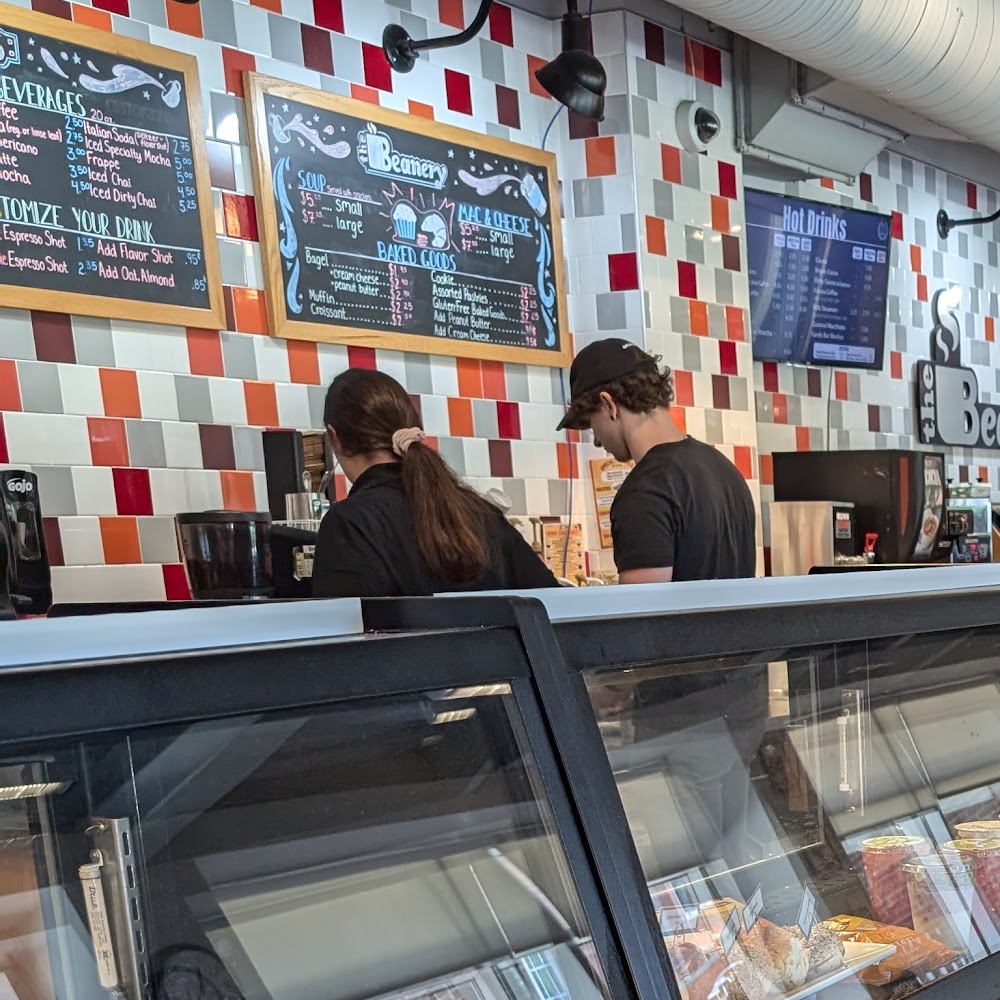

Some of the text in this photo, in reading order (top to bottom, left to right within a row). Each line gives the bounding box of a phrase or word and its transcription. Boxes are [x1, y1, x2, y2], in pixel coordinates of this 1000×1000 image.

[0, 101, 18, 120] ffee
[91, 108, 103, 120] 20
[66, 131, 84, 145] 2.75
[83, 120, 113, 139] Italian
[112, 127, 135, 145] Soda
[67, 147, 85, 161] 3.00
[85, 136, 192, 170] Iced Specialty Mocha 5.00
[366, 131, 447, 188] Beanery
[69, 165, 88, 178] 3.50
[86, 151, 193, 184] Frappe 5.00
[71, 180, 91, 195] 4.50
[88, 166, 196, 198] Iced Chai 4.50
[297, 169, 327, 192] SOUP
[90, 183, 197, 213] Iced Dirty Chai 5.25
[335, 198, 363, 217] small
[0, 195, 156, 244] TOMIZE YOUR DRINK
[336, 216, 364, 239] large
[458, 203, 531, 236] MAC & CHEESE
[783, 204, 848, 240] Hot Drinks
[3, 224, 43, 246] Espresso
[44, 229, 67, 249] Shot
[97, 239, 118, 257] Add
[120, 243, 149, 263] Flavor
[151, 248, 174, 265] Shot
[490, 229, 514, 246] small
[305, 248, 330, 270] Bagel
[376, 240, 457, 273] BAKED GOODS
[491, 245, 515, 264] large
[8, 250, 45, 272] Espresso
[44, 256, 69, 275] Shot
[78, 262, 97, 276] 2.35
[99, 261, 119, 280] Add
[141, 268, 175, 288] Almond
[356, 272, 380, 285] cheese
[431, 270, 454, 286] Cookie
[309, 289, 335, 304] Muffin
[359, 286, 380, 297] butter
[432, 283, 462, 300] Assorted
[463, 287, 488, 304] Pastries
[310, 302, 346, 320] Croissant
[434, 310, 491, 329] Add Peanut Butter
[434, 323, 491, 342] Add Cream Cheese
[921, 362, 937, 443] the
